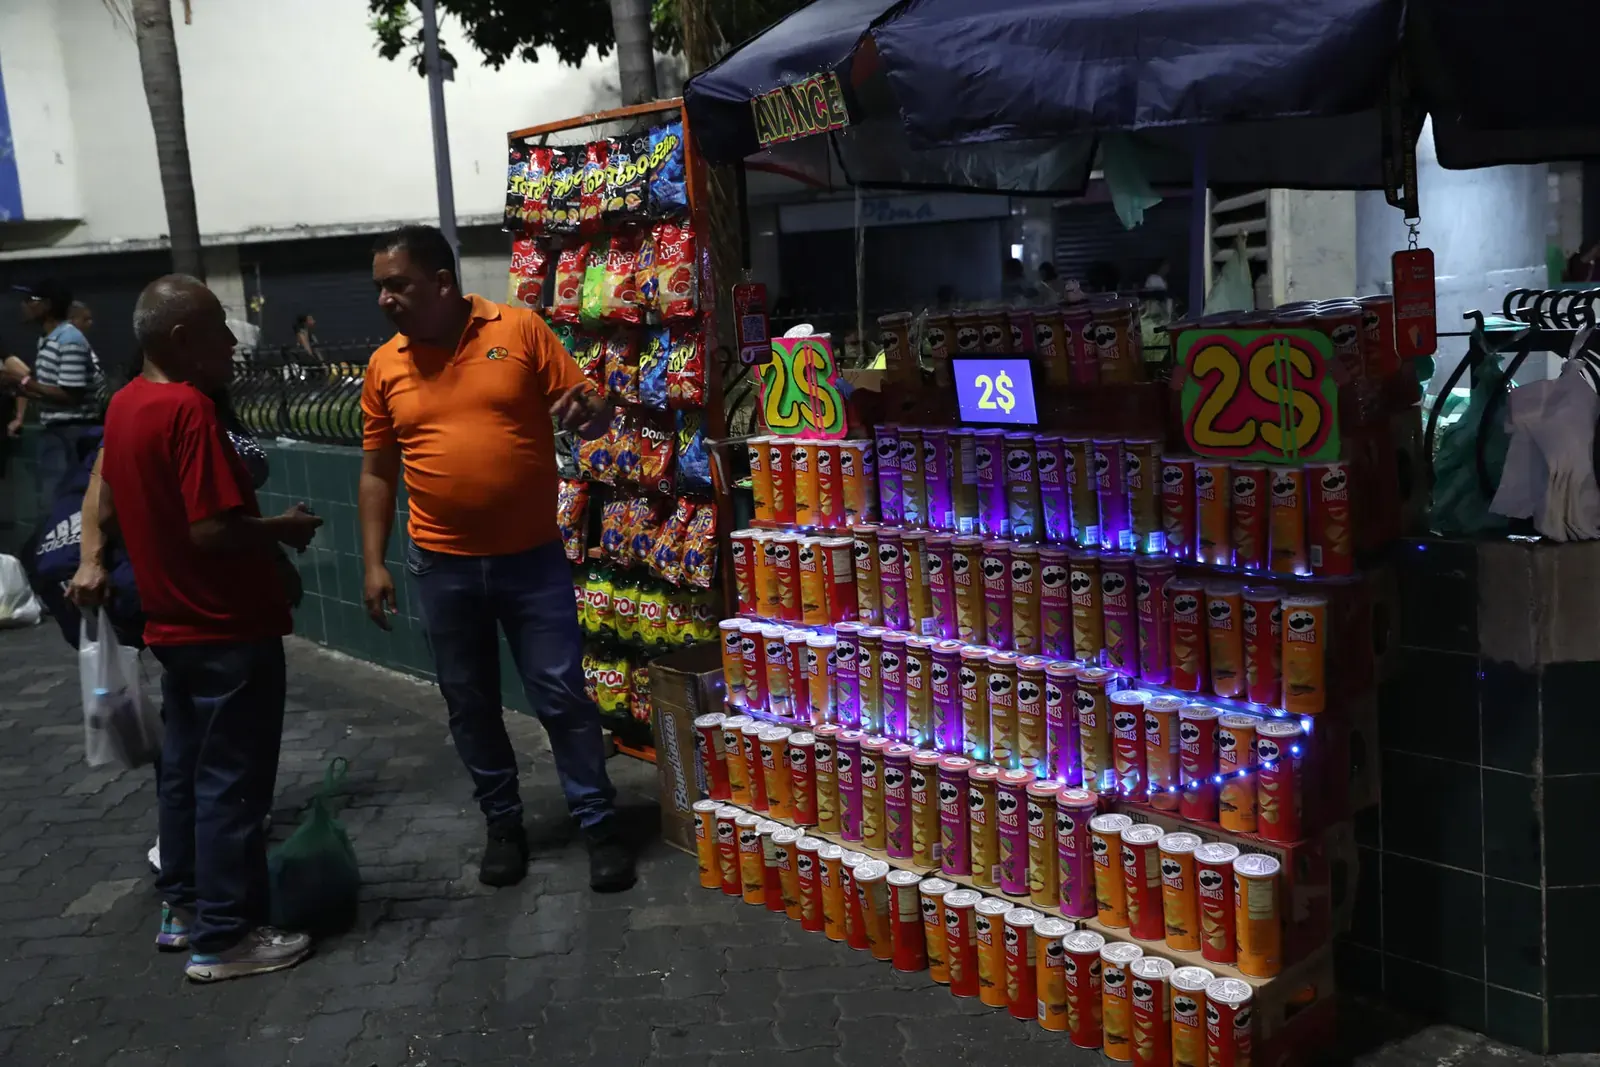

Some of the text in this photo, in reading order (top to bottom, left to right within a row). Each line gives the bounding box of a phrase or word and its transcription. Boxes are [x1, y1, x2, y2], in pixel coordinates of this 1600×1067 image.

[752, 77, 847, 144] AVANCE
[975, 370, 1014, 414] 2$
[1192, 337, 1322, 461] 2$
[1321, 489, 1348, 504] PRINGLES
[1042, 586, 1067, 599] PRINGLES
[1288, 629, 1315, 644] PRINGLES
[664, 713, 688, 810] Bombones
[1104, 985, 1126, 999] PRINGLES
[1173, 1011, 1199, 1028] PRINGLES
